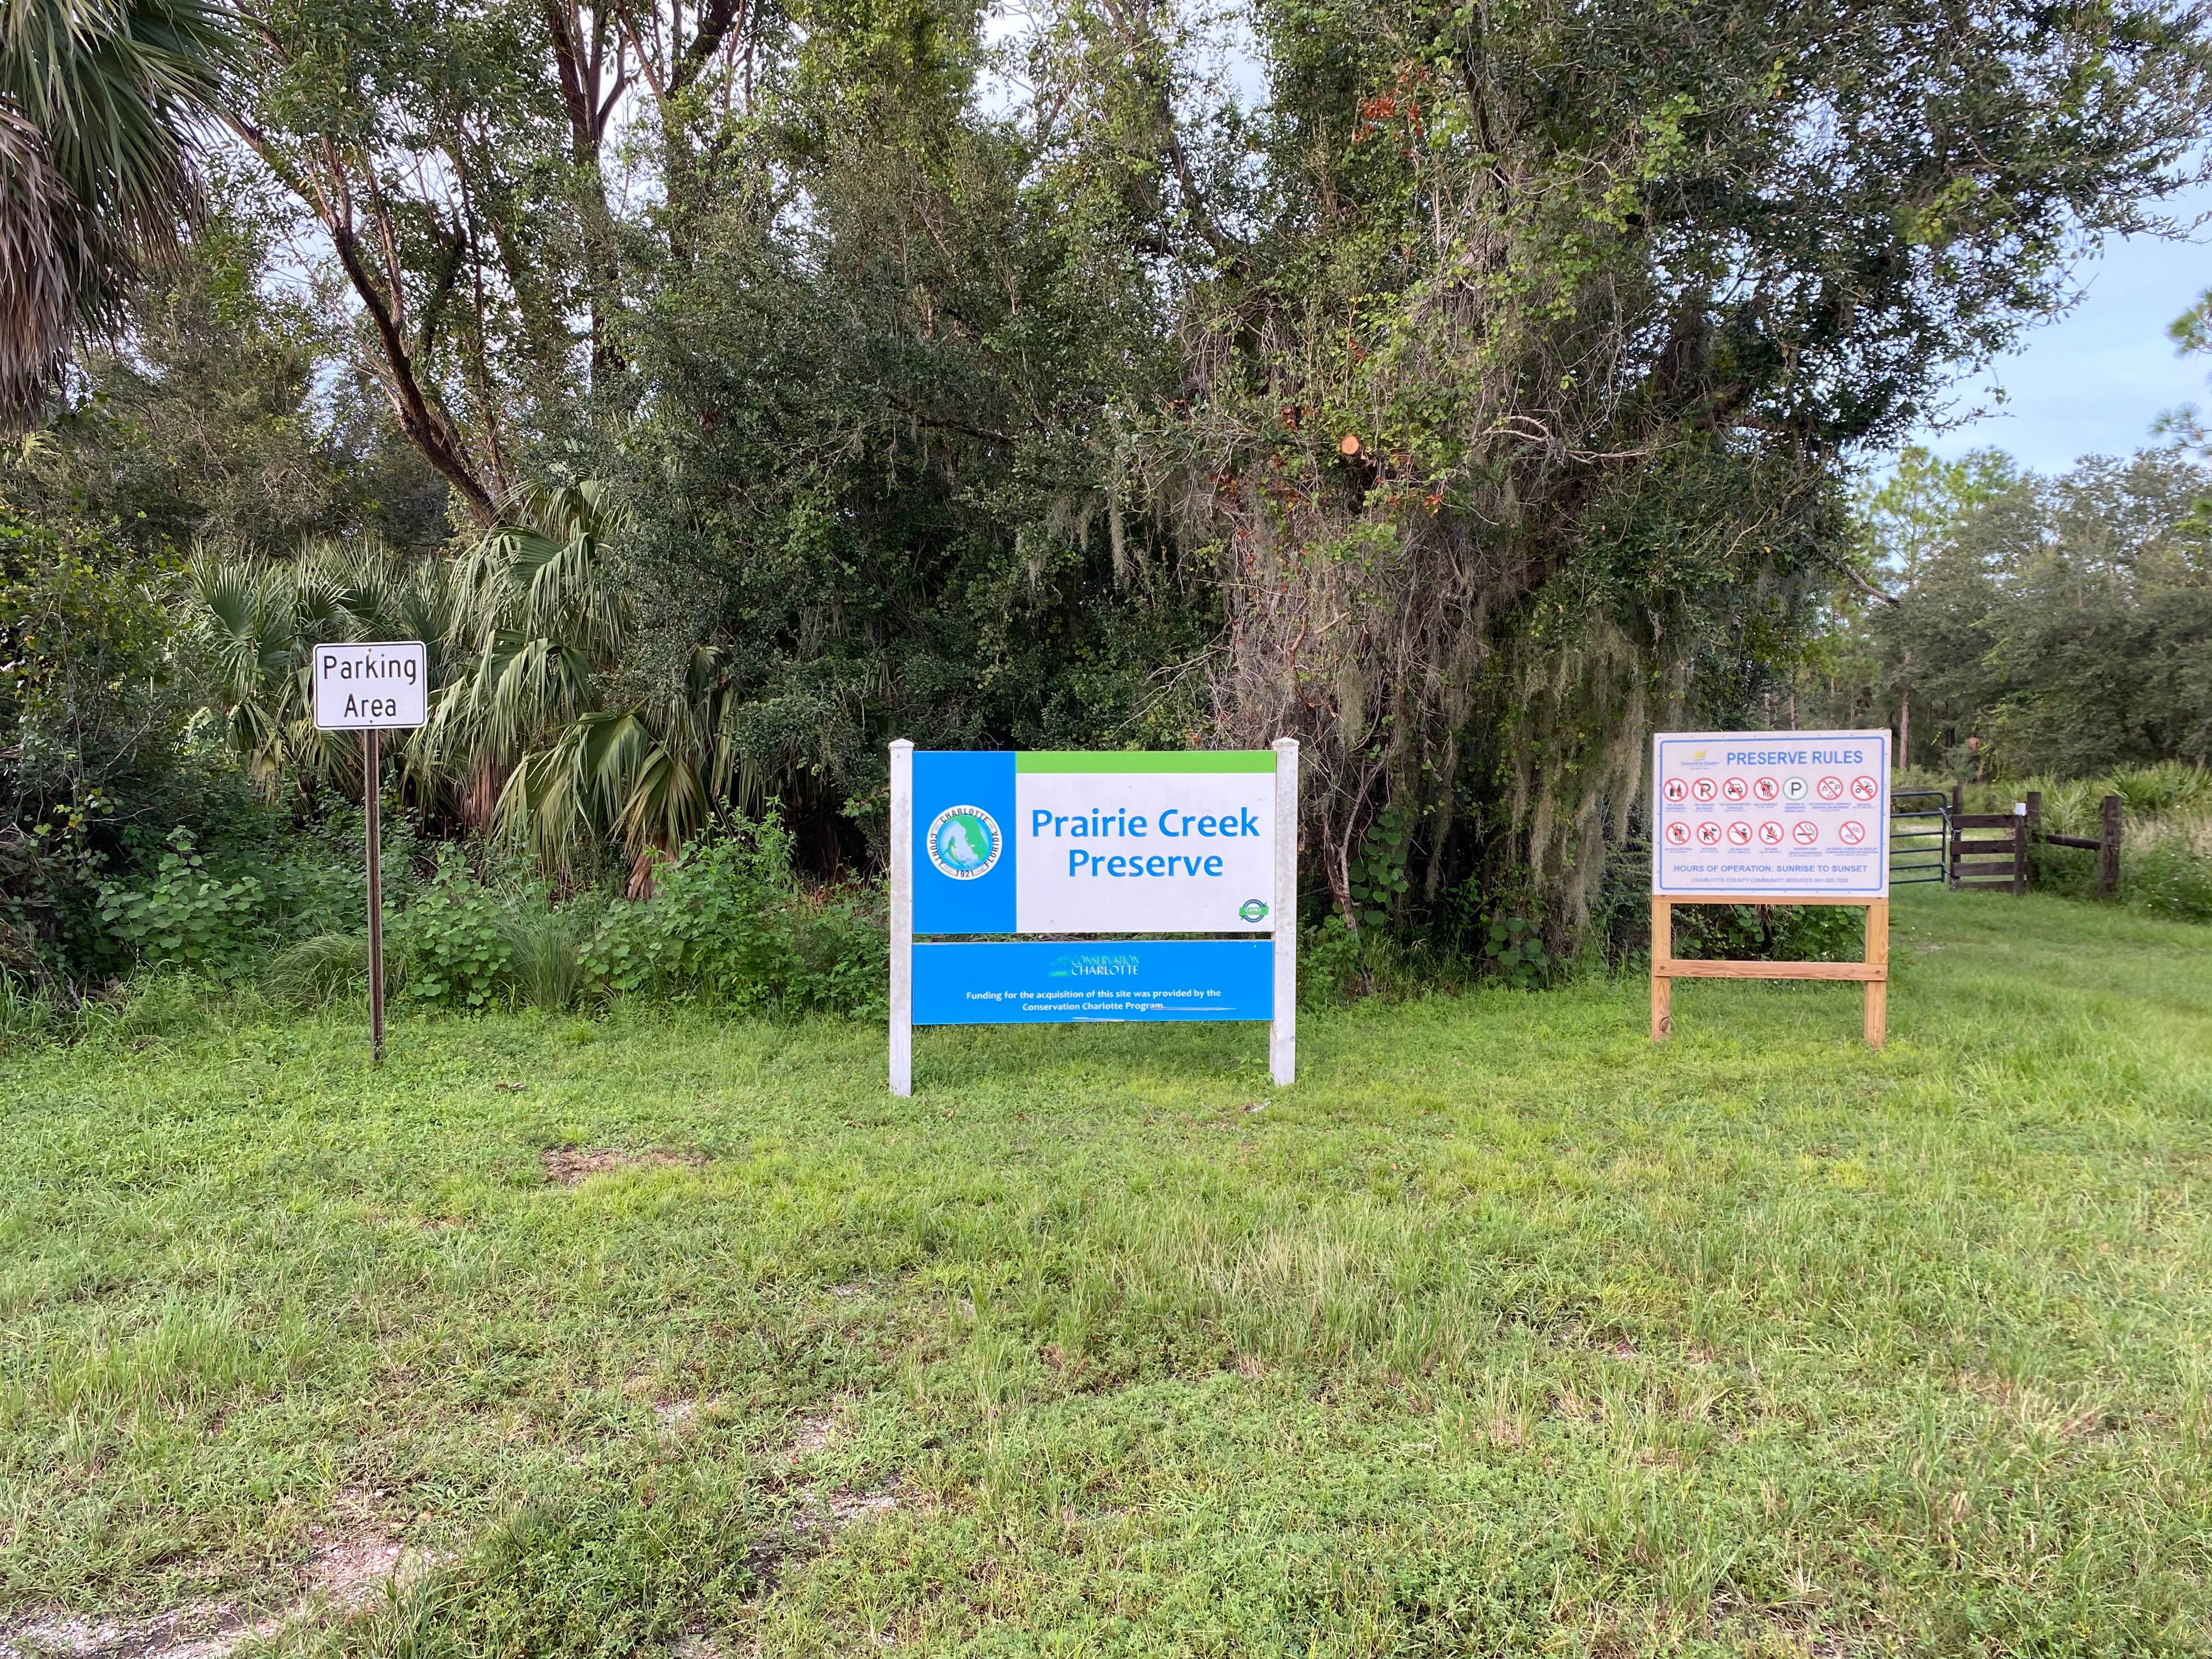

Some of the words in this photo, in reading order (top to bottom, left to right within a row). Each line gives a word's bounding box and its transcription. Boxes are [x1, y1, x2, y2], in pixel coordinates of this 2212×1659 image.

[324, 654, 416, 685] Parking
[343, 693, 396, 718] Area
[1726, 751, 1807, 765] PRESERVE
[1812, 751, 1863, 764] RULES
[940, 808, 990, 823] CHARLOTTE
[1032, 808, 1147, 837] Prairie
[1159, 807, 1260, 837] Creek
[930, 833, 945, 866] COUNTY
[984, 831, 999, 867] FLORIDA
[1069, 849, 1223, 877] Preserve
[1071, 955, 1139, 966] CONSERVATION
[1071, 965, 1139, 975] CHARLOTTE
[966, 991, 1002, 1001] Funding
[1005, 991, 1017, 999] for
[1036, 990, 1084, 1000] acquisition
[1086, 990, 1096, 998] of
[1153, 989, 1192, 999] provided
[1194, 989, 1204, 999] by
[1022, 1002, 1080, 1011] Conservation
[1082, 1002, 1124, 1010] Charlotte
